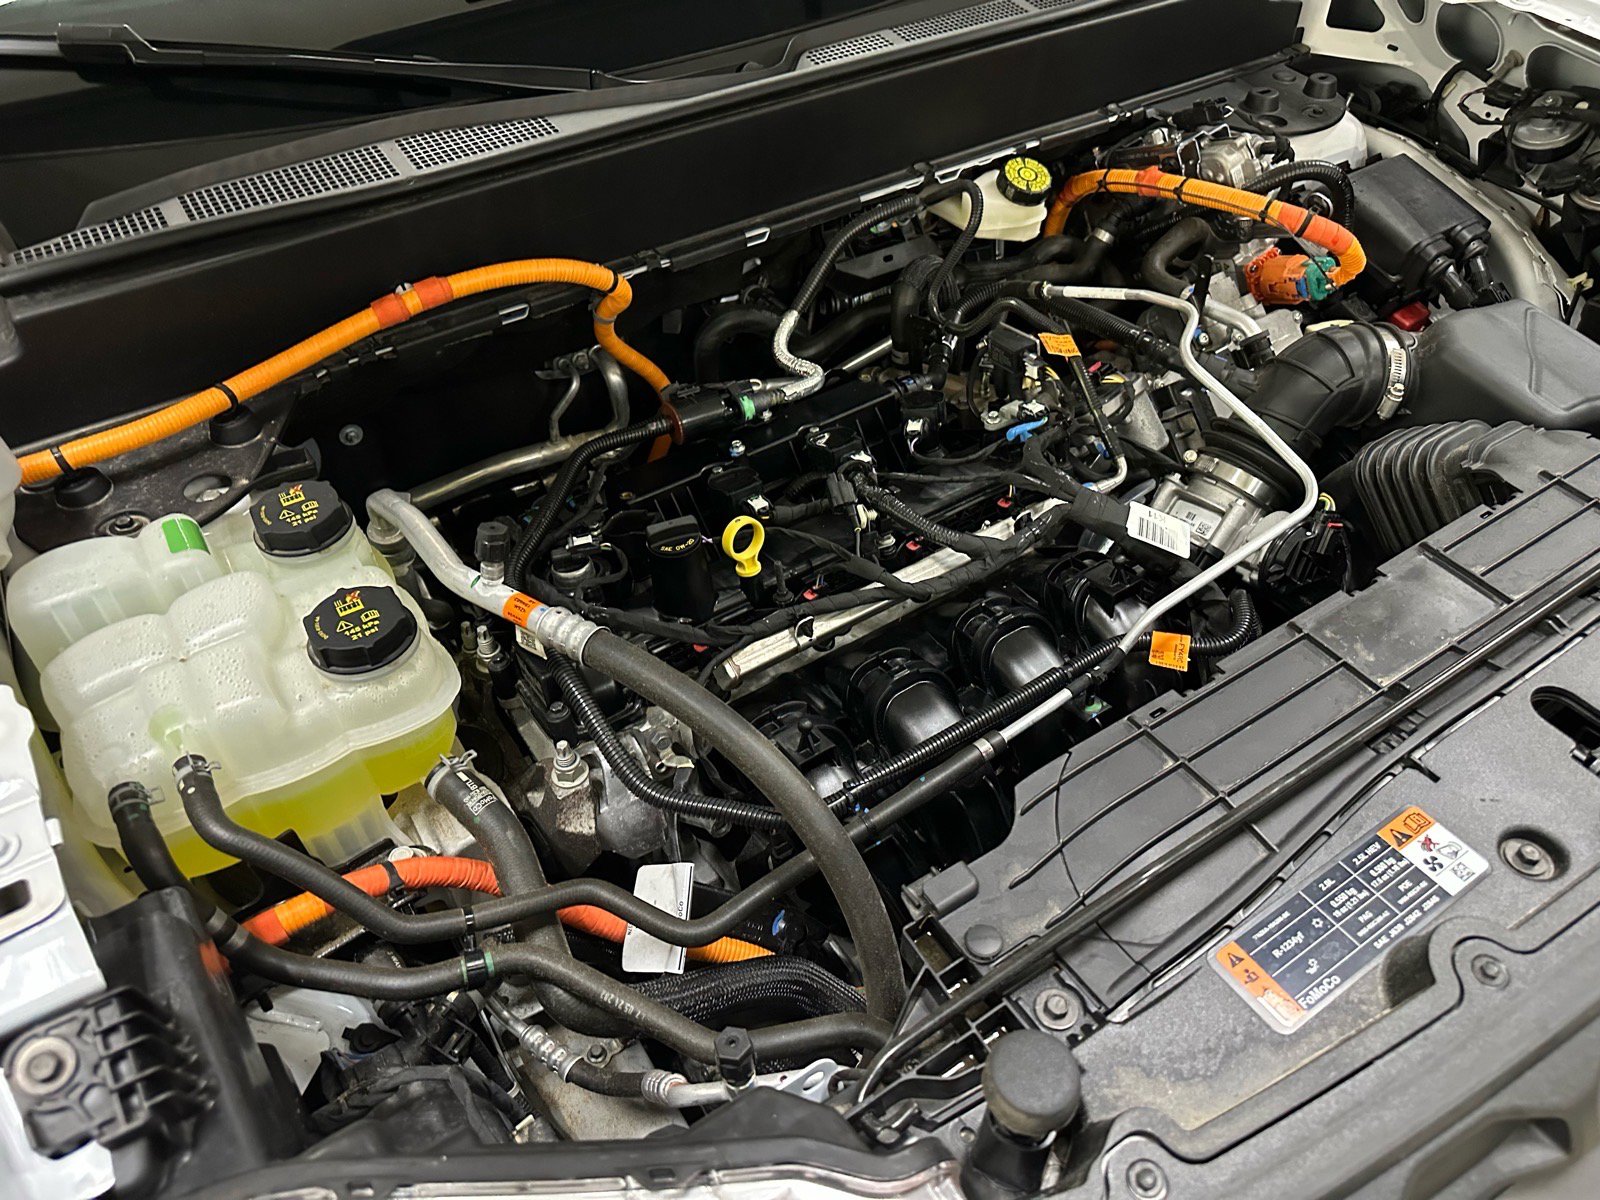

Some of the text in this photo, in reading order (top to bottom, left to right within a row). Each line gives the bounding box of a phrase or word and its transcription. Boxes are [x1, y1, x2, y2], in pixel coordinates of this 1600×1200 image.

[659, 544, 673, 552] SAE
[344, 620, 380, 636] 145 kPa
[352, 627, 378, 640] 21 psi
[1367, 842, 1380, 855] HEV
[1385, 856, 1396, 867] kg
[1346, 887, 1357, 897] kg
[1272, 932, 1305, 959] R-1234yf
[1373, 937, 1389, 948] SAE
[1298, 975, 1341, 1008] FoMoCo
